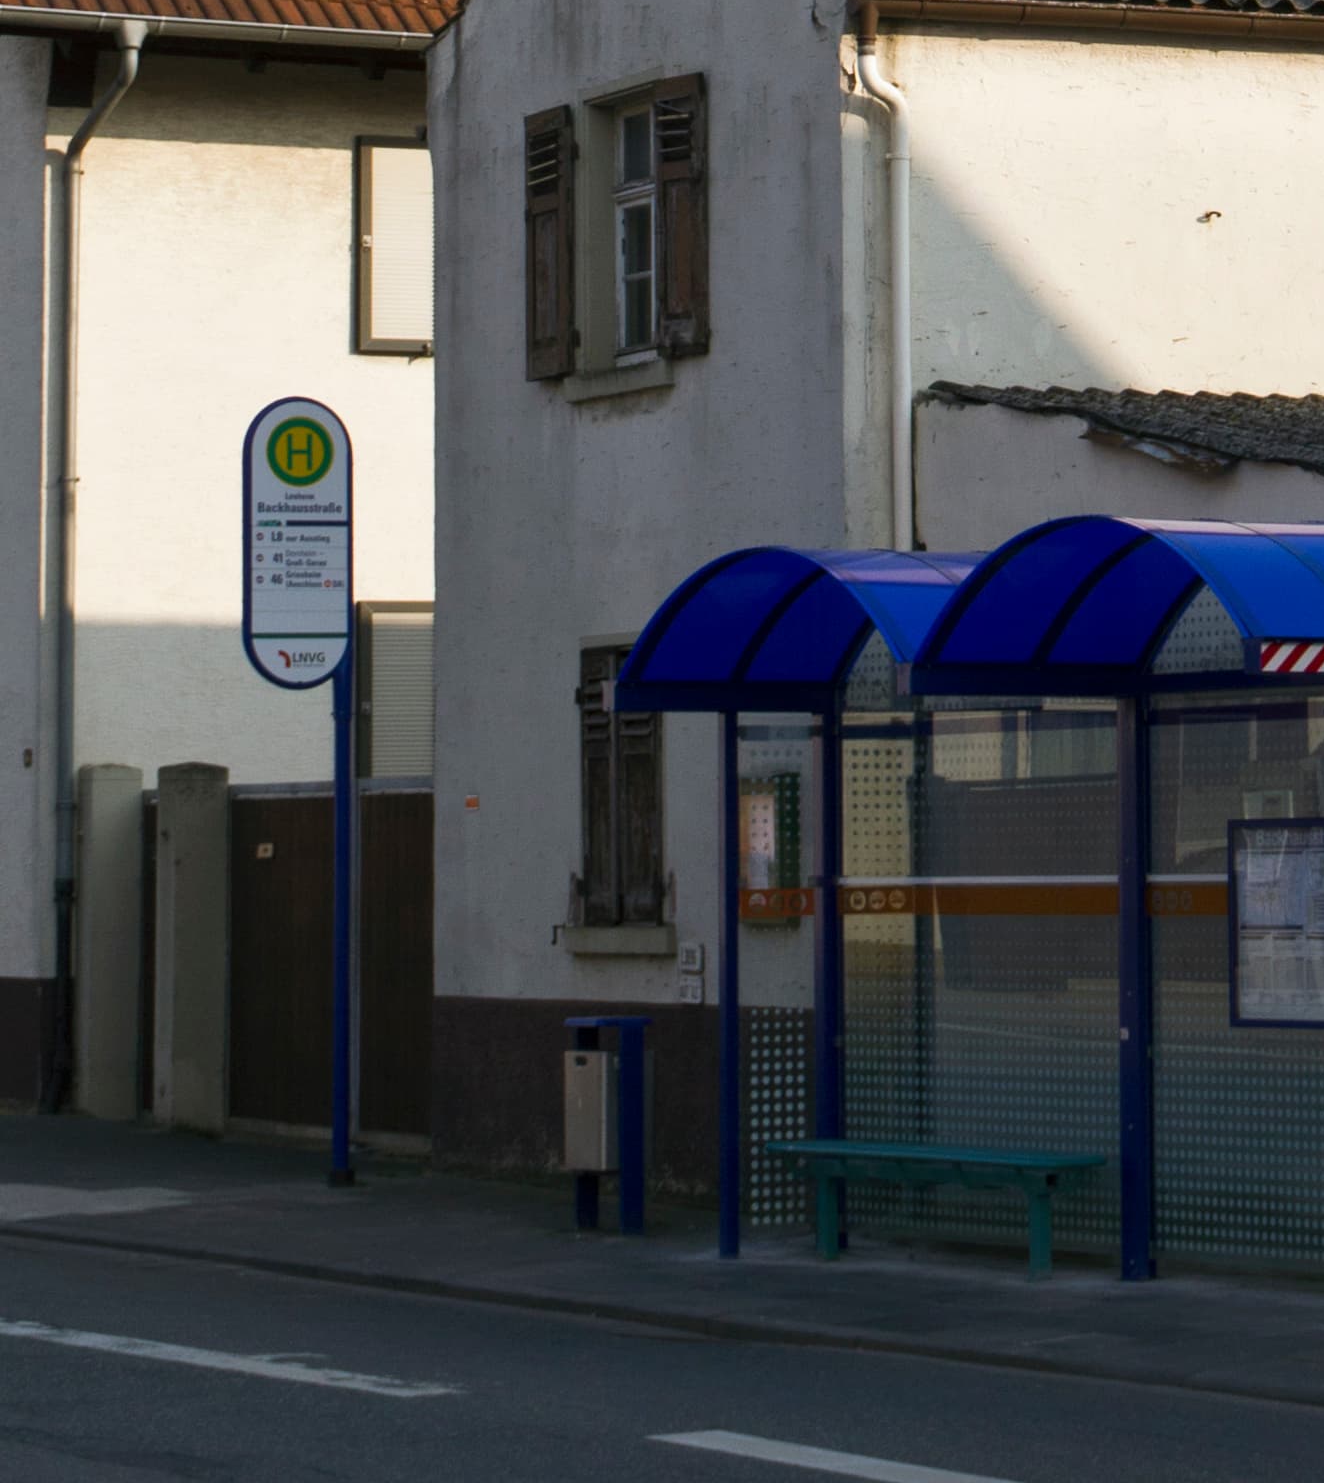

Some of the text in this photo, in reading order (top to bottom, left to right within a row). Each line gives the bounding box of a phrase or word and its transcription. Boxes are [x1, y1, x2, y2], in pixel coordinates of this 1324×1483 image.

[286, 433, 313, 471] H
[257, 501, 343, 514] Backhausstraße
[273, 552, 283, 563] 41
[292, 651, 326, 663] LNVG
